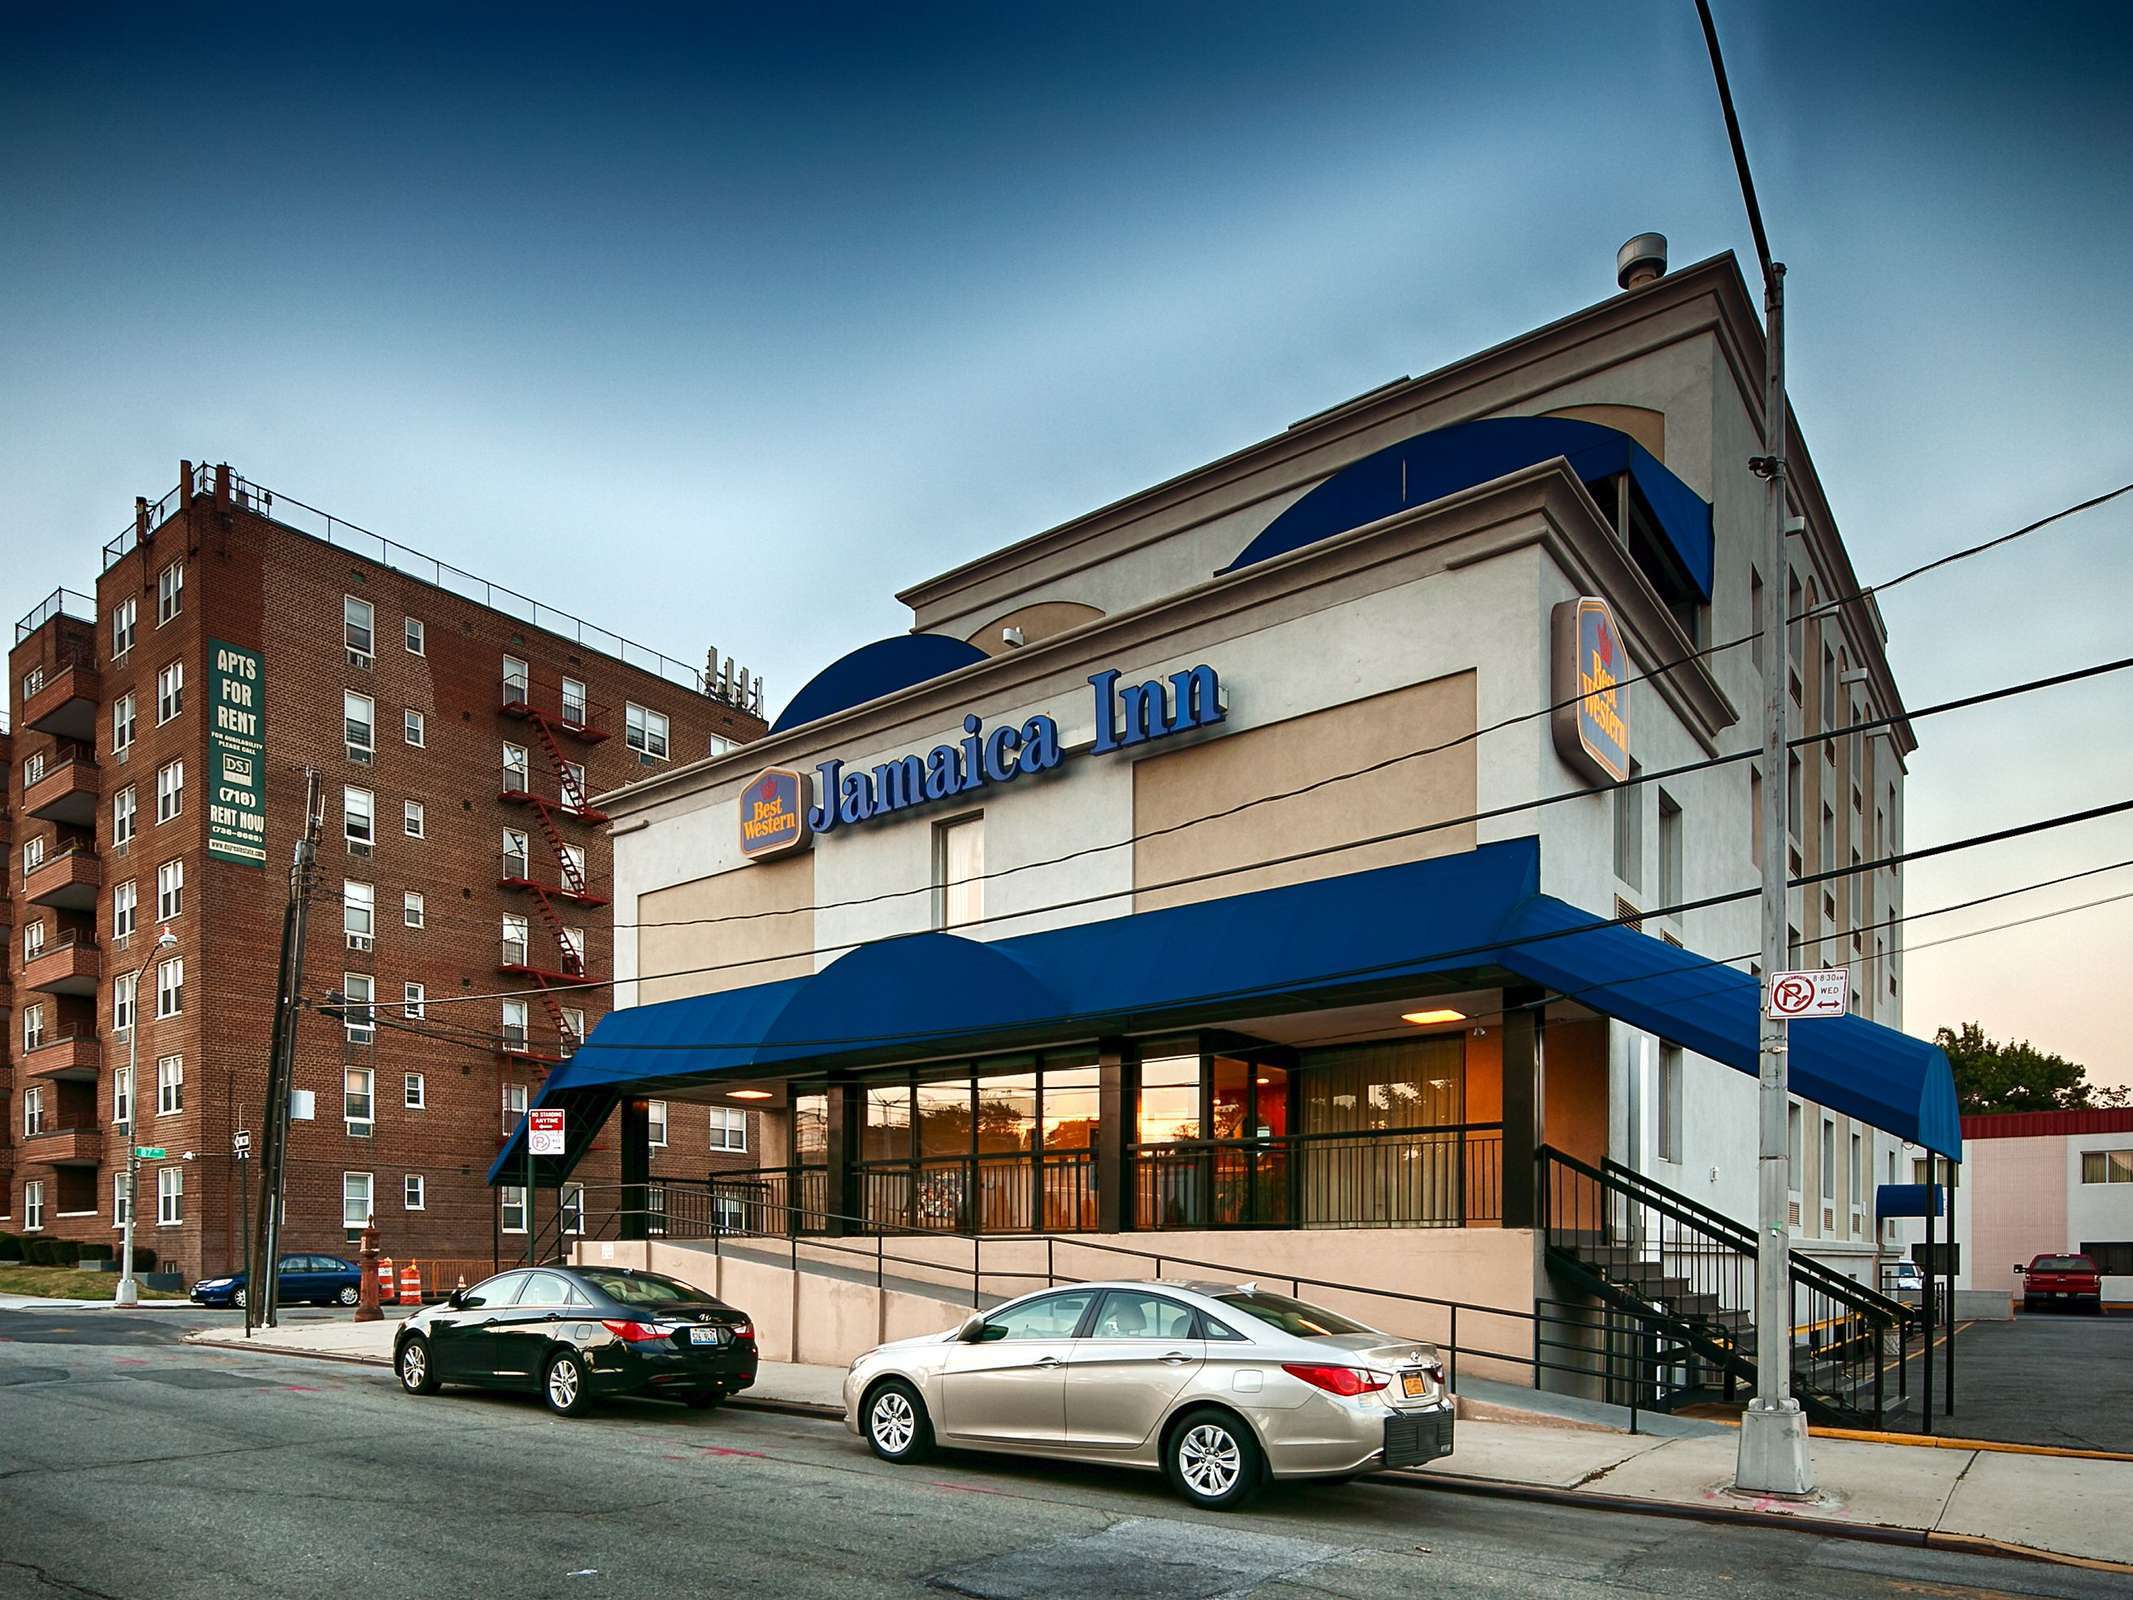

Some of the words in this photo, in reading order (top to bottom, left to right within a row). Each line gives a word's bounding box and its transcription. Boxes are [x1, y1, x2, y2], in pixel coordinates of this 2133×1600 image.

[217, 649, 256, 680] APTS
[1592, 649, 1617, 708] Best
[222, 678, 252, 707] FOR
[218, 705, 256, 736] RENT
[1582, 671, 1626, 752] Western
[211, 731, 224, 740] FOR
[218, 740, 241, 751] PLEASE
[241, 746, 256, 756] CALL
[808, 713, 1064, 834] Jamaica
[1087, 663, 1227, 757] Inn
[225, 757, 250, 774] DSJ
[219, 786, 256, 808] (718)
[753, 795, 783, 821] Best
[210, 804, 237, 827] RENT
[240, 811, 265, 833] NOW
[743, 812, 796, 841] Western
[1820, 986, 1840, 995] WED
